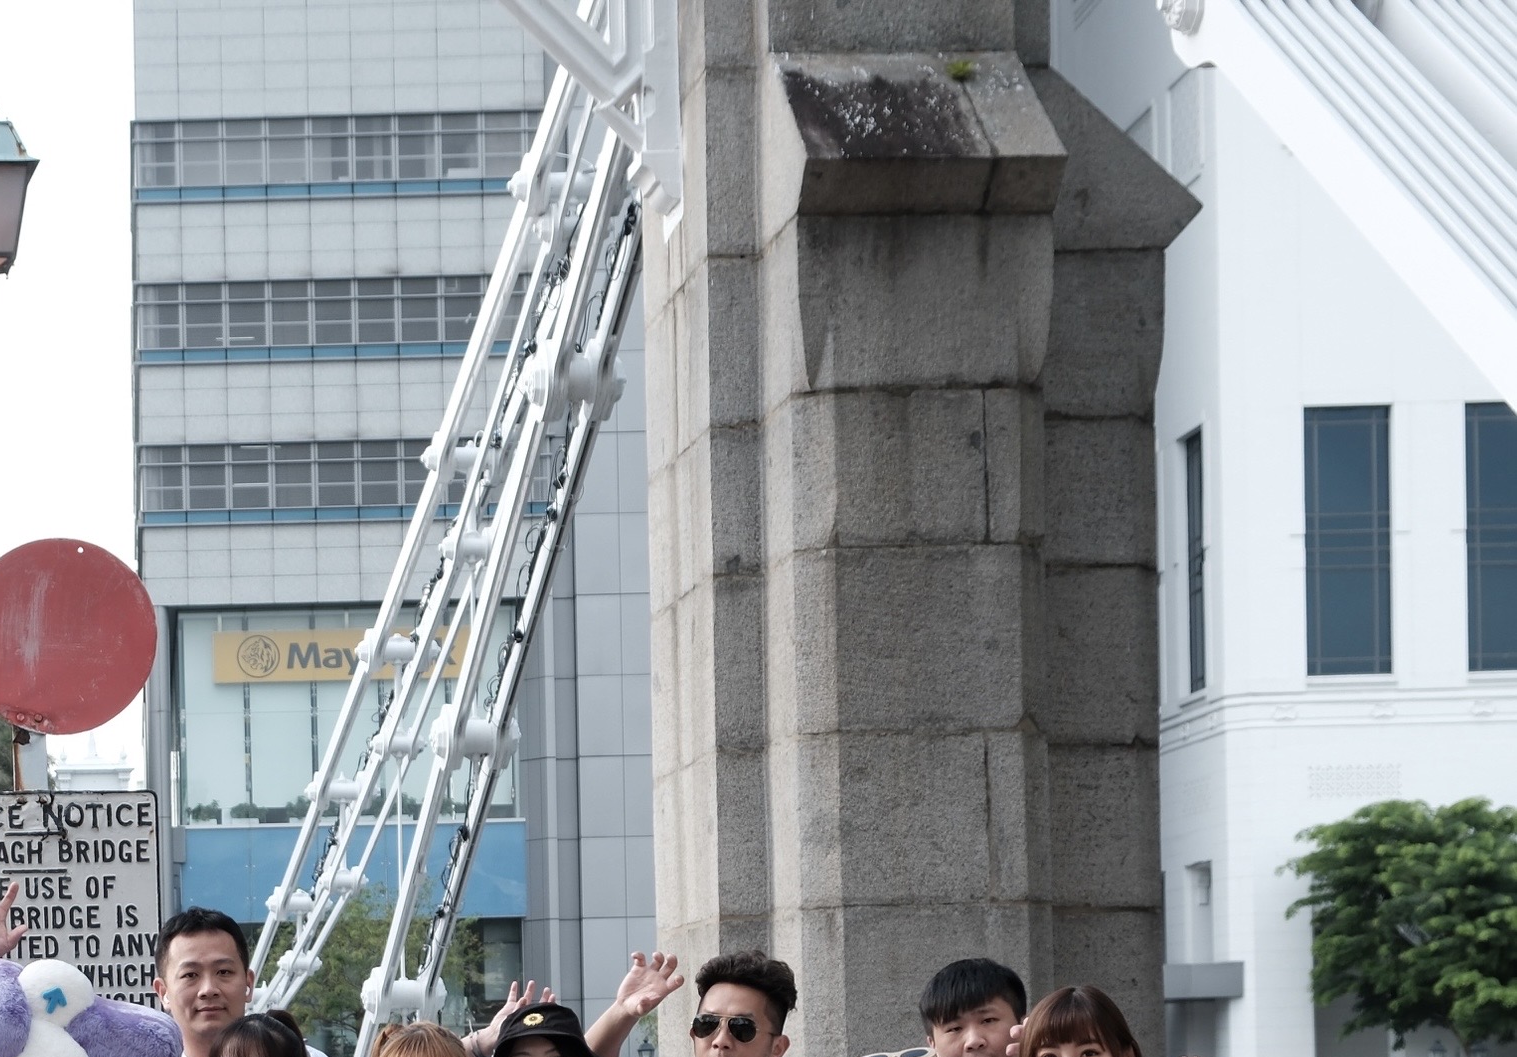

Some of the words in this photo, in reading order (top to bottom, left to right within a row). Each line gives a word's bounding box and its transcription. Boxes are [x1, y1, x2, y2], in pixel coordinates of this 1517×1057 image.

[43, 801, 153, 828] NOTICE
[58, 839, 150, 863] BRIDGE
[25, 876, 72, 900] USE
[85, 875, 116, 899] OF
[10, 905, 100, 930] BRIDGE
[116, 904, 138, 928] IS
[69, 934, 100, 958] TO
[112, 933, 158, 957] ANY
